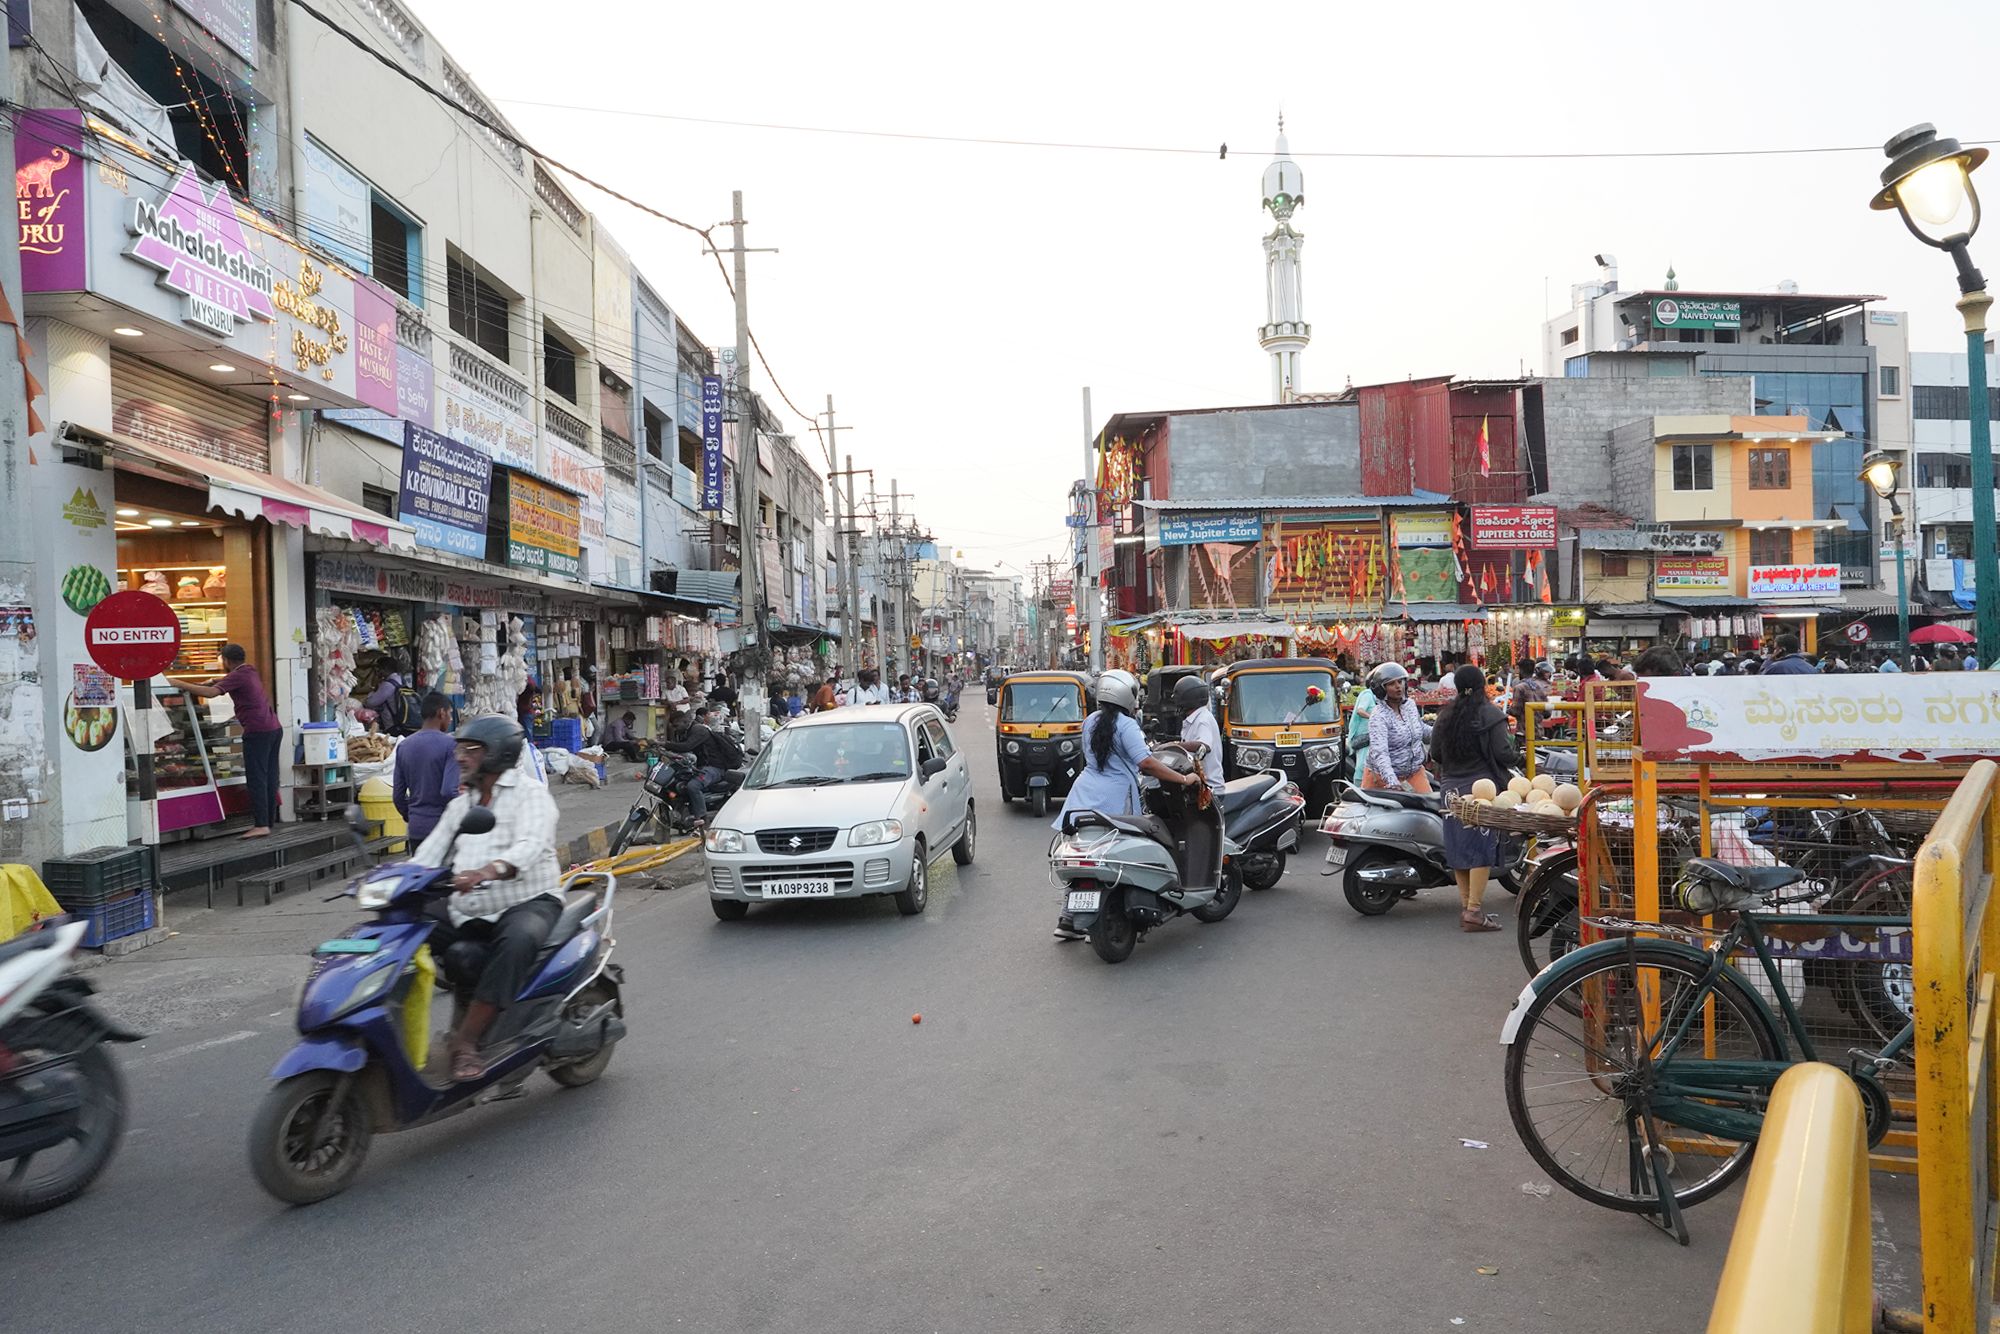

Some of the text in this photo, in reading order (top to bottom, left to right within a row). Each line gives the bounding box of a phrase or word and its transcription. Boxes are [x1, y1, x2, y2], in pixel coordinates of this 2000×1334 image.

[196, 208, 222, 237] SHREE
[136, 200, 272, 294] Mahalakshmi
[185, 268, 239, 312] SWEETS
[191, 298, 234, 333] MYSURU
[1681, 312, 1740, 321] NAIVEDYAM VEG
[358, 339, 382, 361] TASTE
[359, 354, 393, 381] MYSURU
[407, 386, 429, 413] Setty
[467, 489, 489, 514] SETTY
[1164, 528, 1258, 540] New Jupiter Store
[1476, 530, 1555, 539] JUPITER STORES
[99, 629, 168, 641] NO ENTRY
[1743, 690, 1904, 742] ಮೈಸೂರು
[771, 882, 829, 895] KA09P9238
